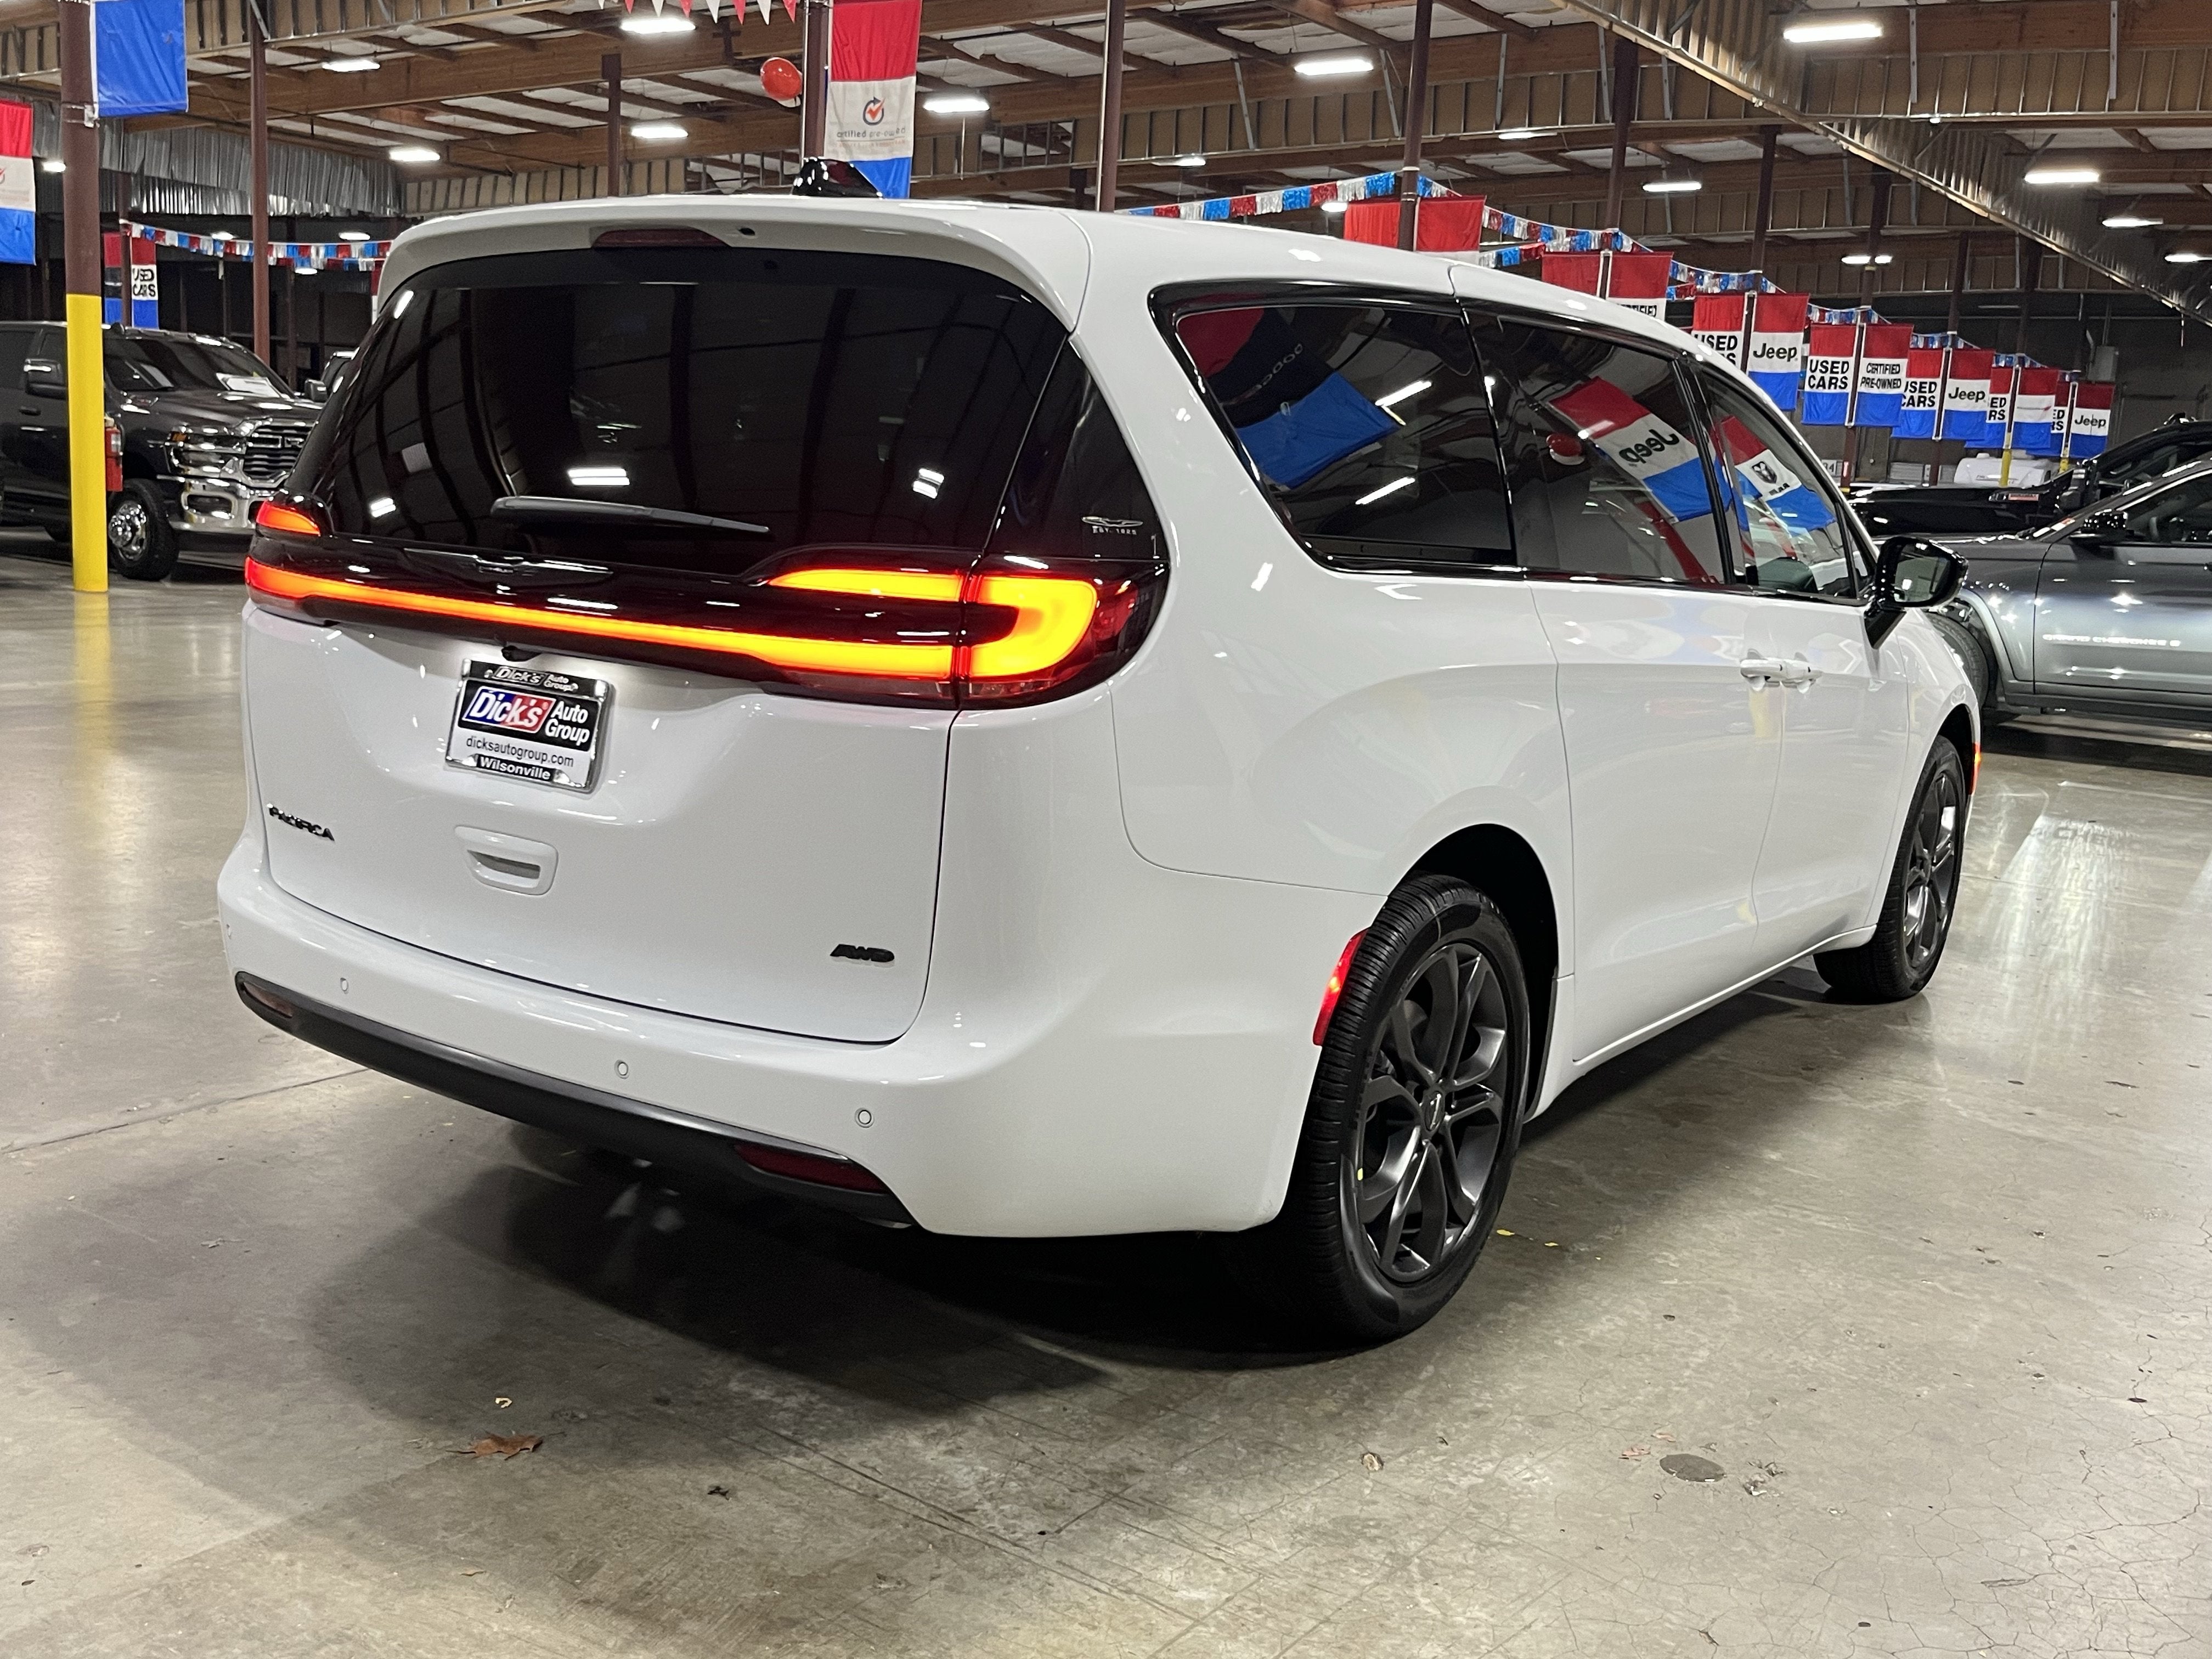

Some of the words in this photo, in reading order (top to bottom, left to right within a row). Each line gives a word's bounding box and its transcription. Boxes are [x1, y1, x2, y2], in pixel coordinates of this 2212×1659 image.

[869, 127, 906, 137] pre-owed
[132, 268, 155, 282] UED
[1753, 343, 1797, 362] Jeep
[1809, 360, 1849, 374] USED
[1866, 362, 1900, 375] CERTIFIED
[1808, 375, 1848, 390] CARS
[1861, 376, 1901, 389] PRE-OWNED
[1948, 387, 1985, 403] Jeep
[1989, 397, 2007, 408] ED
[1988, 409, 2006, 421] RS
[2074, 415, 2106, 428] Jeep
[469, 691, 544, 728] Dick's
[551, 701, 588, 724] Auto
[545, 718, 590, 746] Group
[466, 736, 574, 768] dicksautogroup.com
[479, 755, 551, 781] Wilsonville
